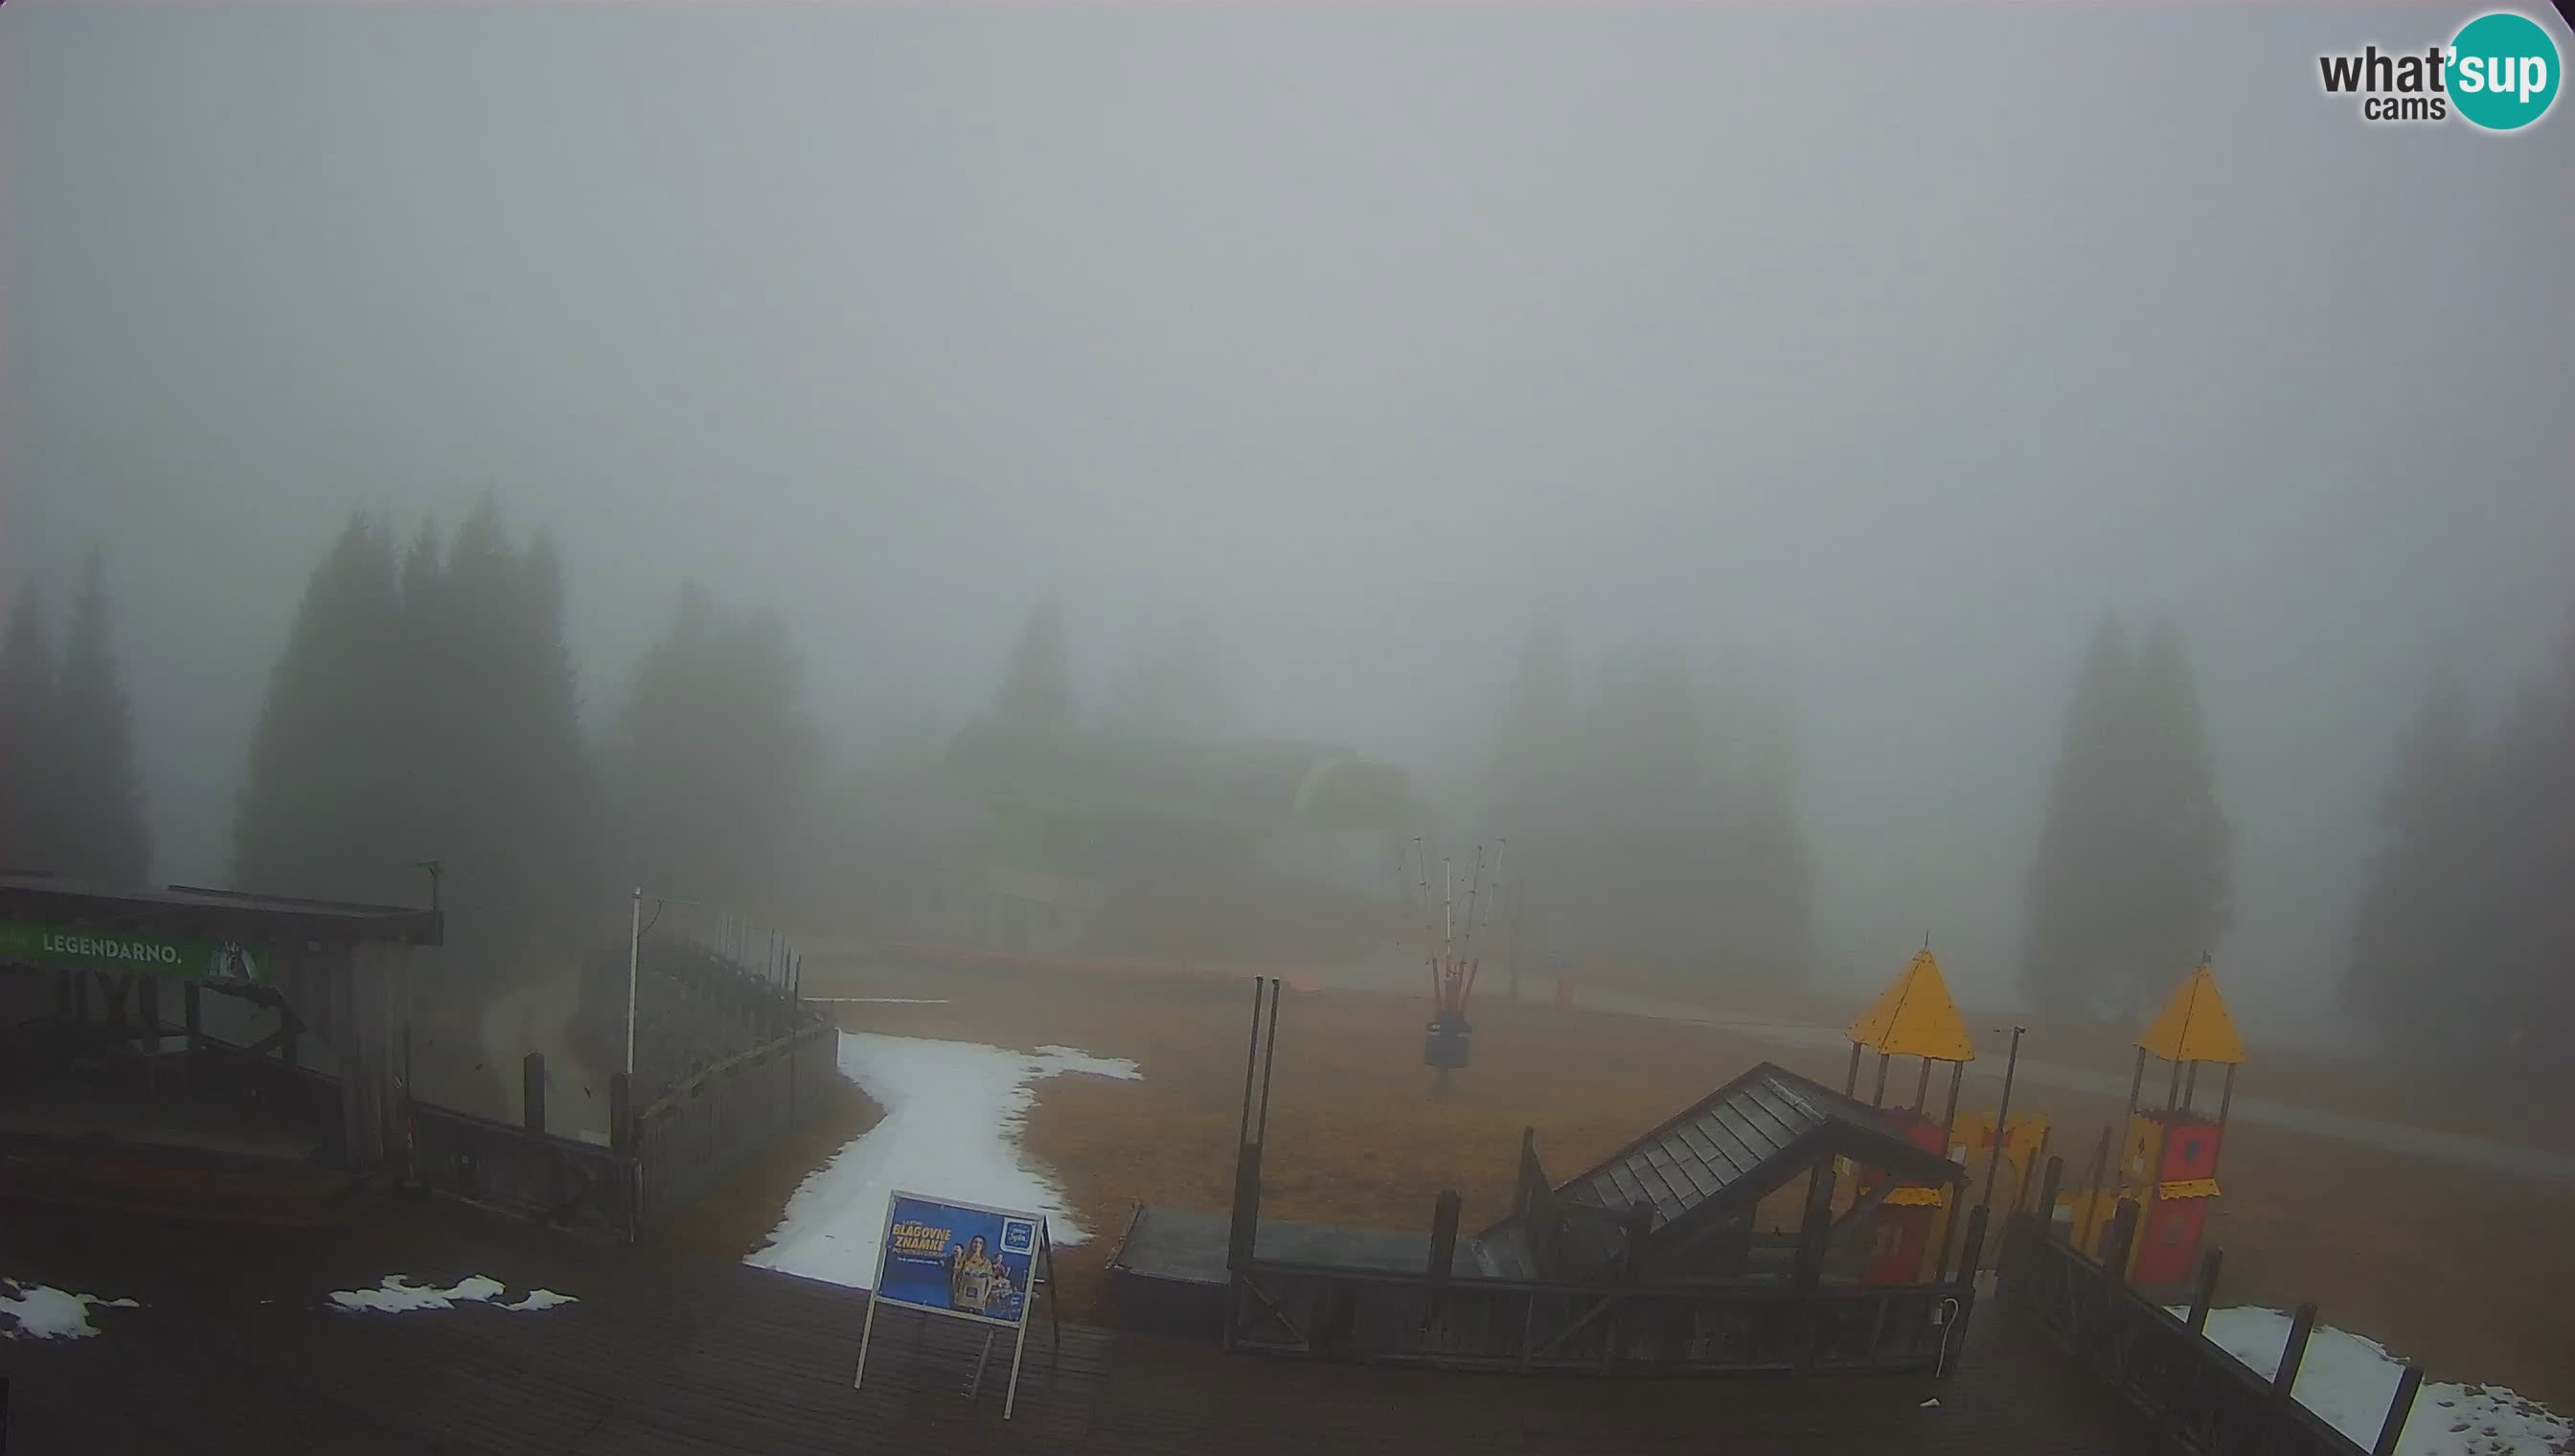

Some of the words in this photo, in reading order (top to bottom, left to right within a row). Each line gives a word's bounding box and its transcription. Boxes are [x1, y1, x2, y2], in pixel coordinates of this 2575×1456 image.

[42, 933, 182, 965] LEGENDARNO.
[892, 1223, 952, 1241] BLAGOVNE
[895, 1236, 946, 1252] ZNAMKE
